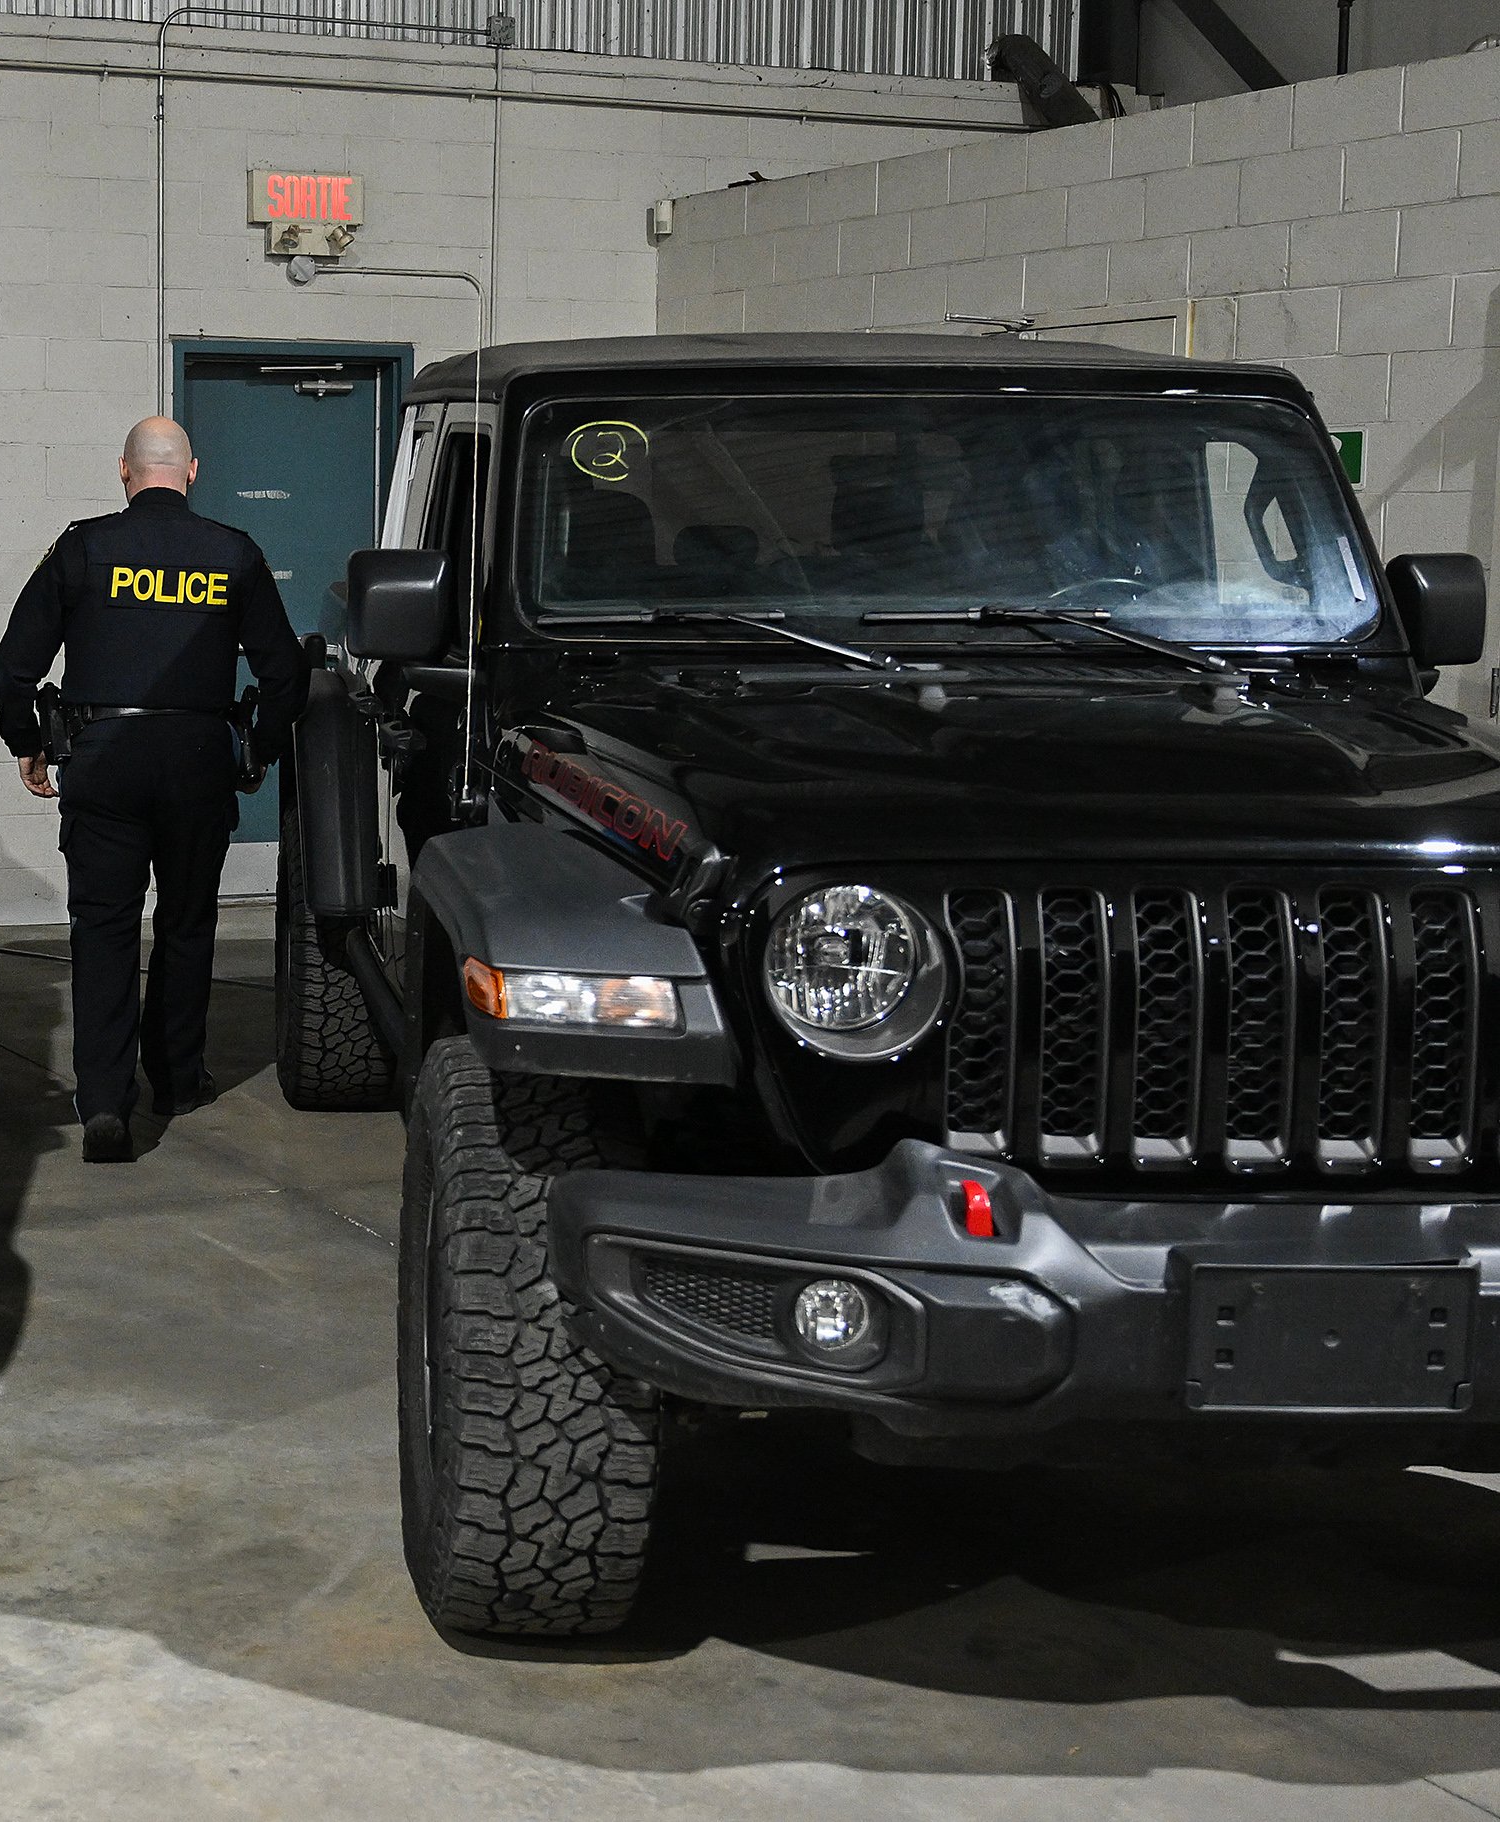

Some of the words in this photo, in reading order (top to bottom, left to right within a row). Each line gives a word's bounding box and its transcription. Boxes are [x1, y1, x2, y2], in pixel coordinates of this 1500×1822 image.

[267, 174, 353, 221] SORTIE
[592, 431, 629, 467] 2
[110, 566, 229, 606] POLICE
[520, 738, 689, 862] RUBICON
